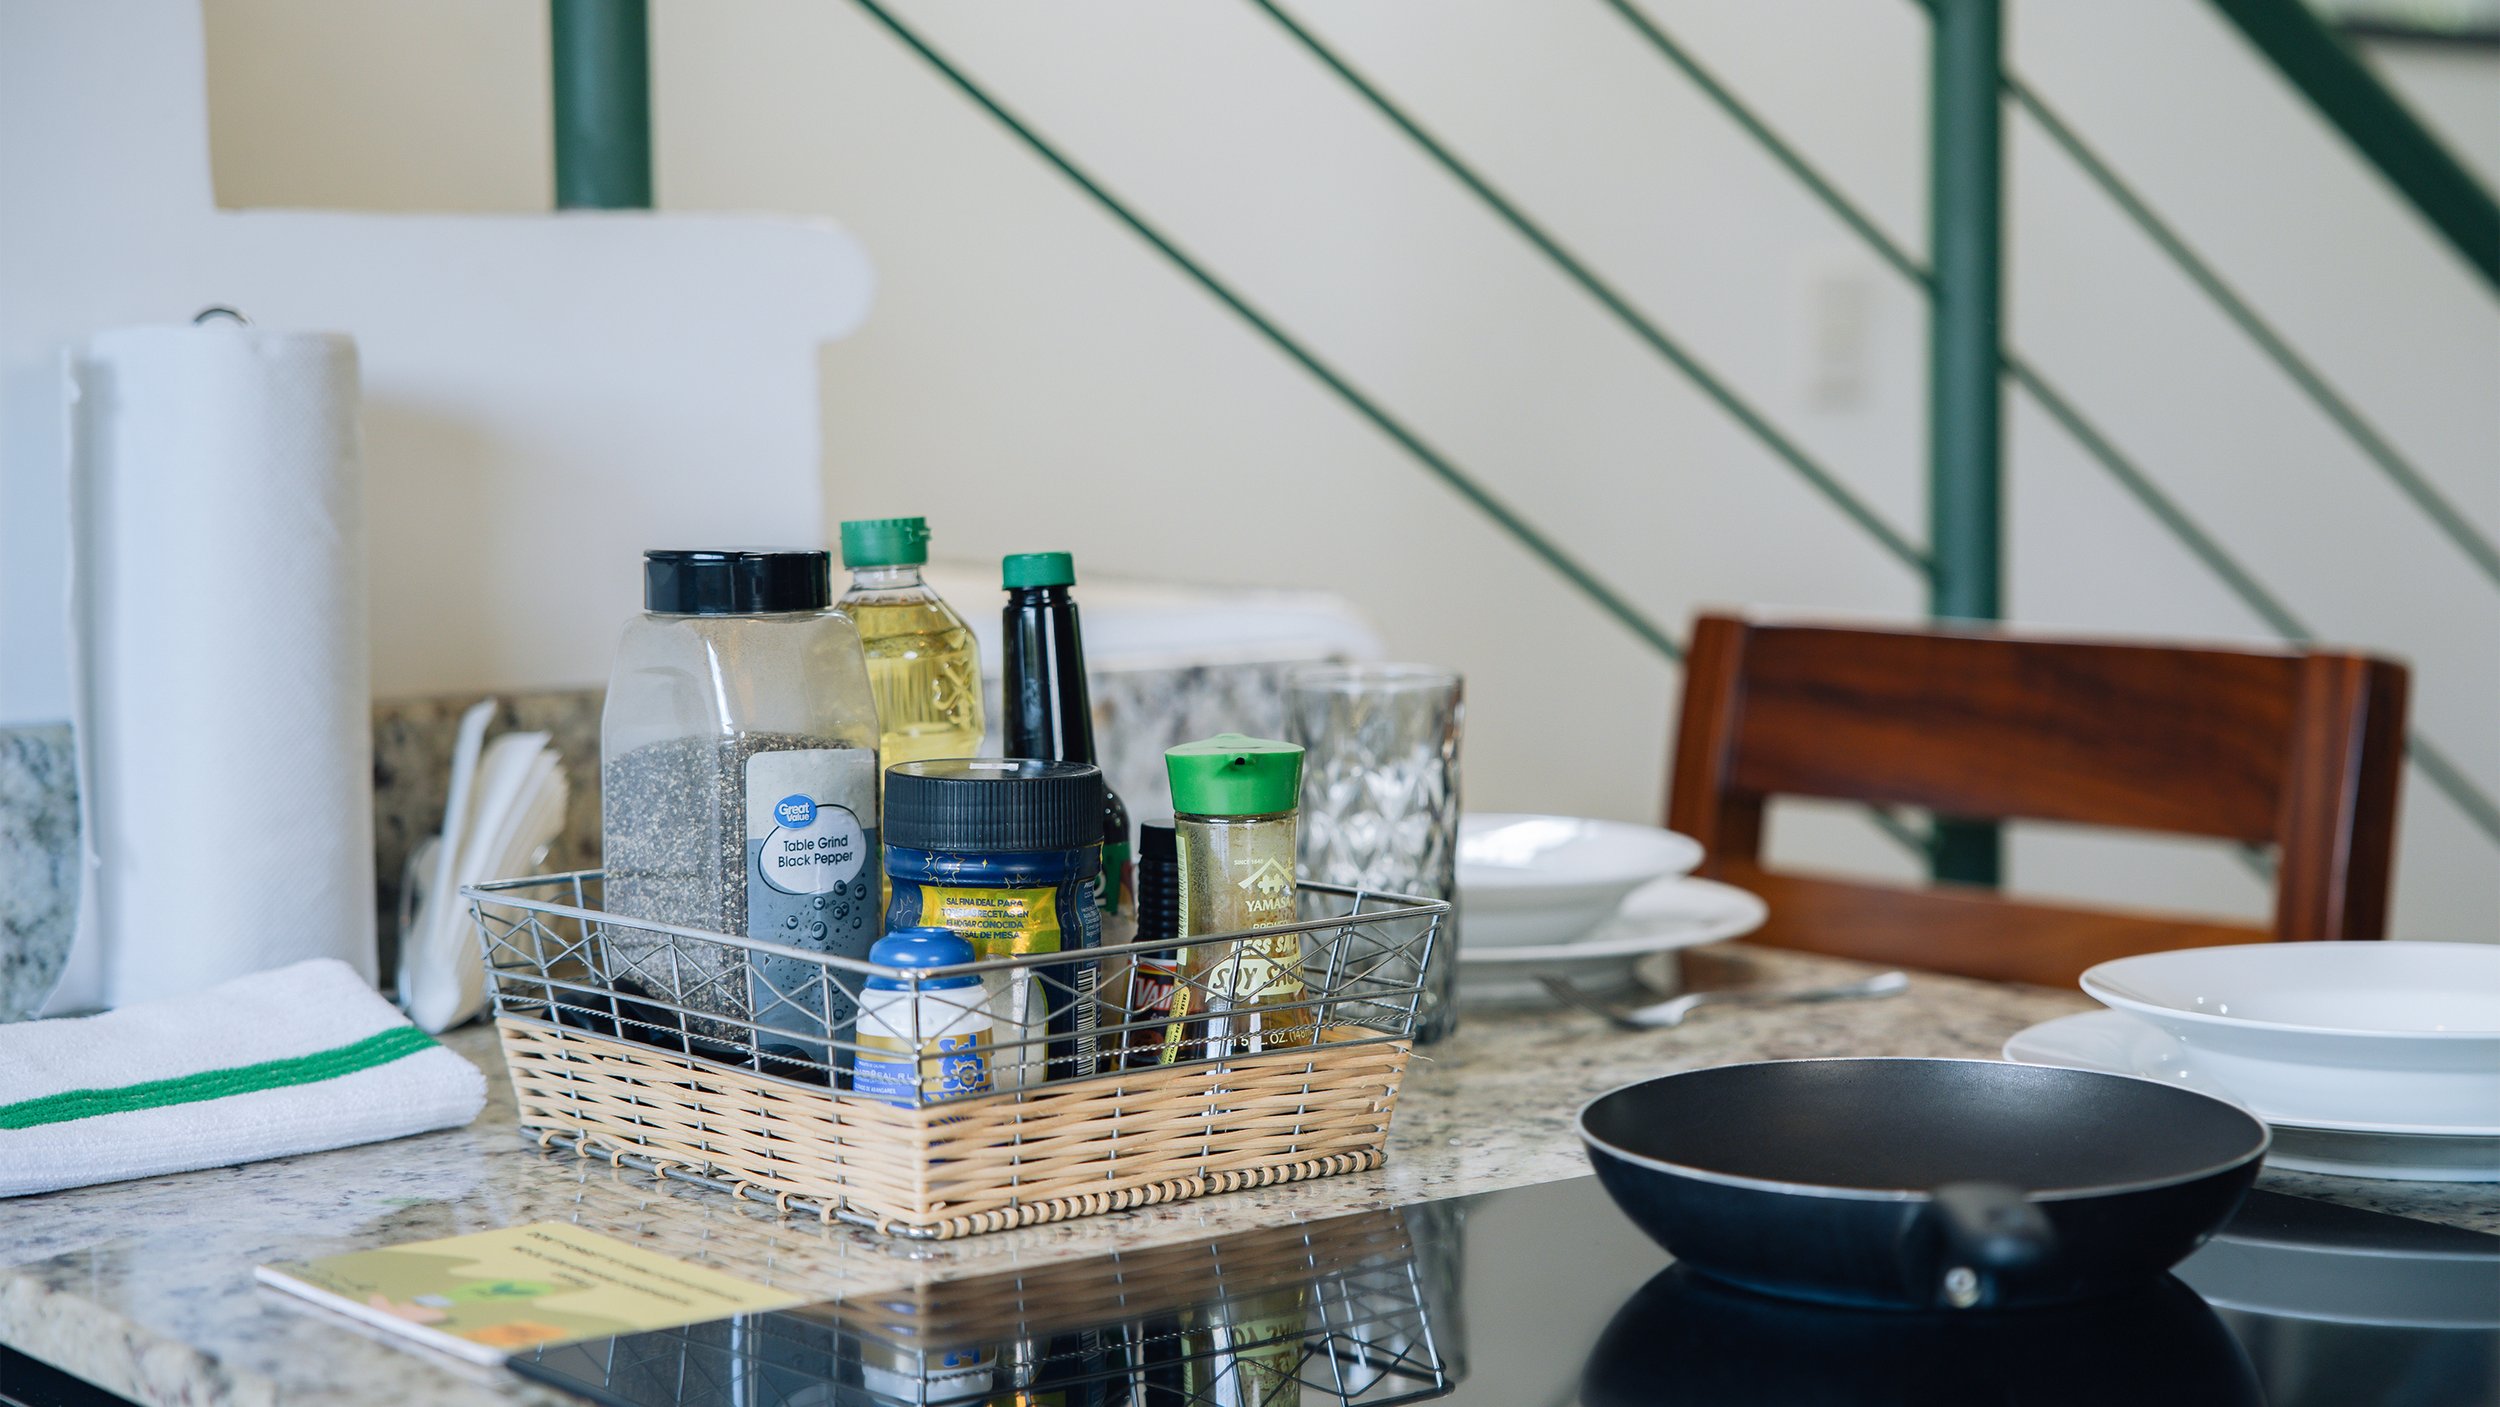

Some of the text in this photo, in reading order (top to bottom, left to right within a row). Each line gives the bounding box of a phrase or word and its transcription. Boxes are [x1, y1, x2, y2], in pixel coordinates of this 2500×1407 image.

[779, 802, 810, 816] Great
[786, 813, 810, 822] Value
[784, 835, 848, 852] Table Grind
[778, 852, 853, 868] Black Pepper
[946, 897, 1024, 908] SAL FINA IDEAL PARA
[977, 909, 1016, 918] RECETAS
[953, 919, 977, 928] HOGAR
[977, 920, 1024, 929] CONOCIDA
[965, 930, 979, 939] SAL
[979, 931, 992, 939] DE
[993, 931, 1020, 939] MESA
[1212, 960, 1304, 990] SOY SAU
[1269, 1032, 1288, 1044] OZ.
